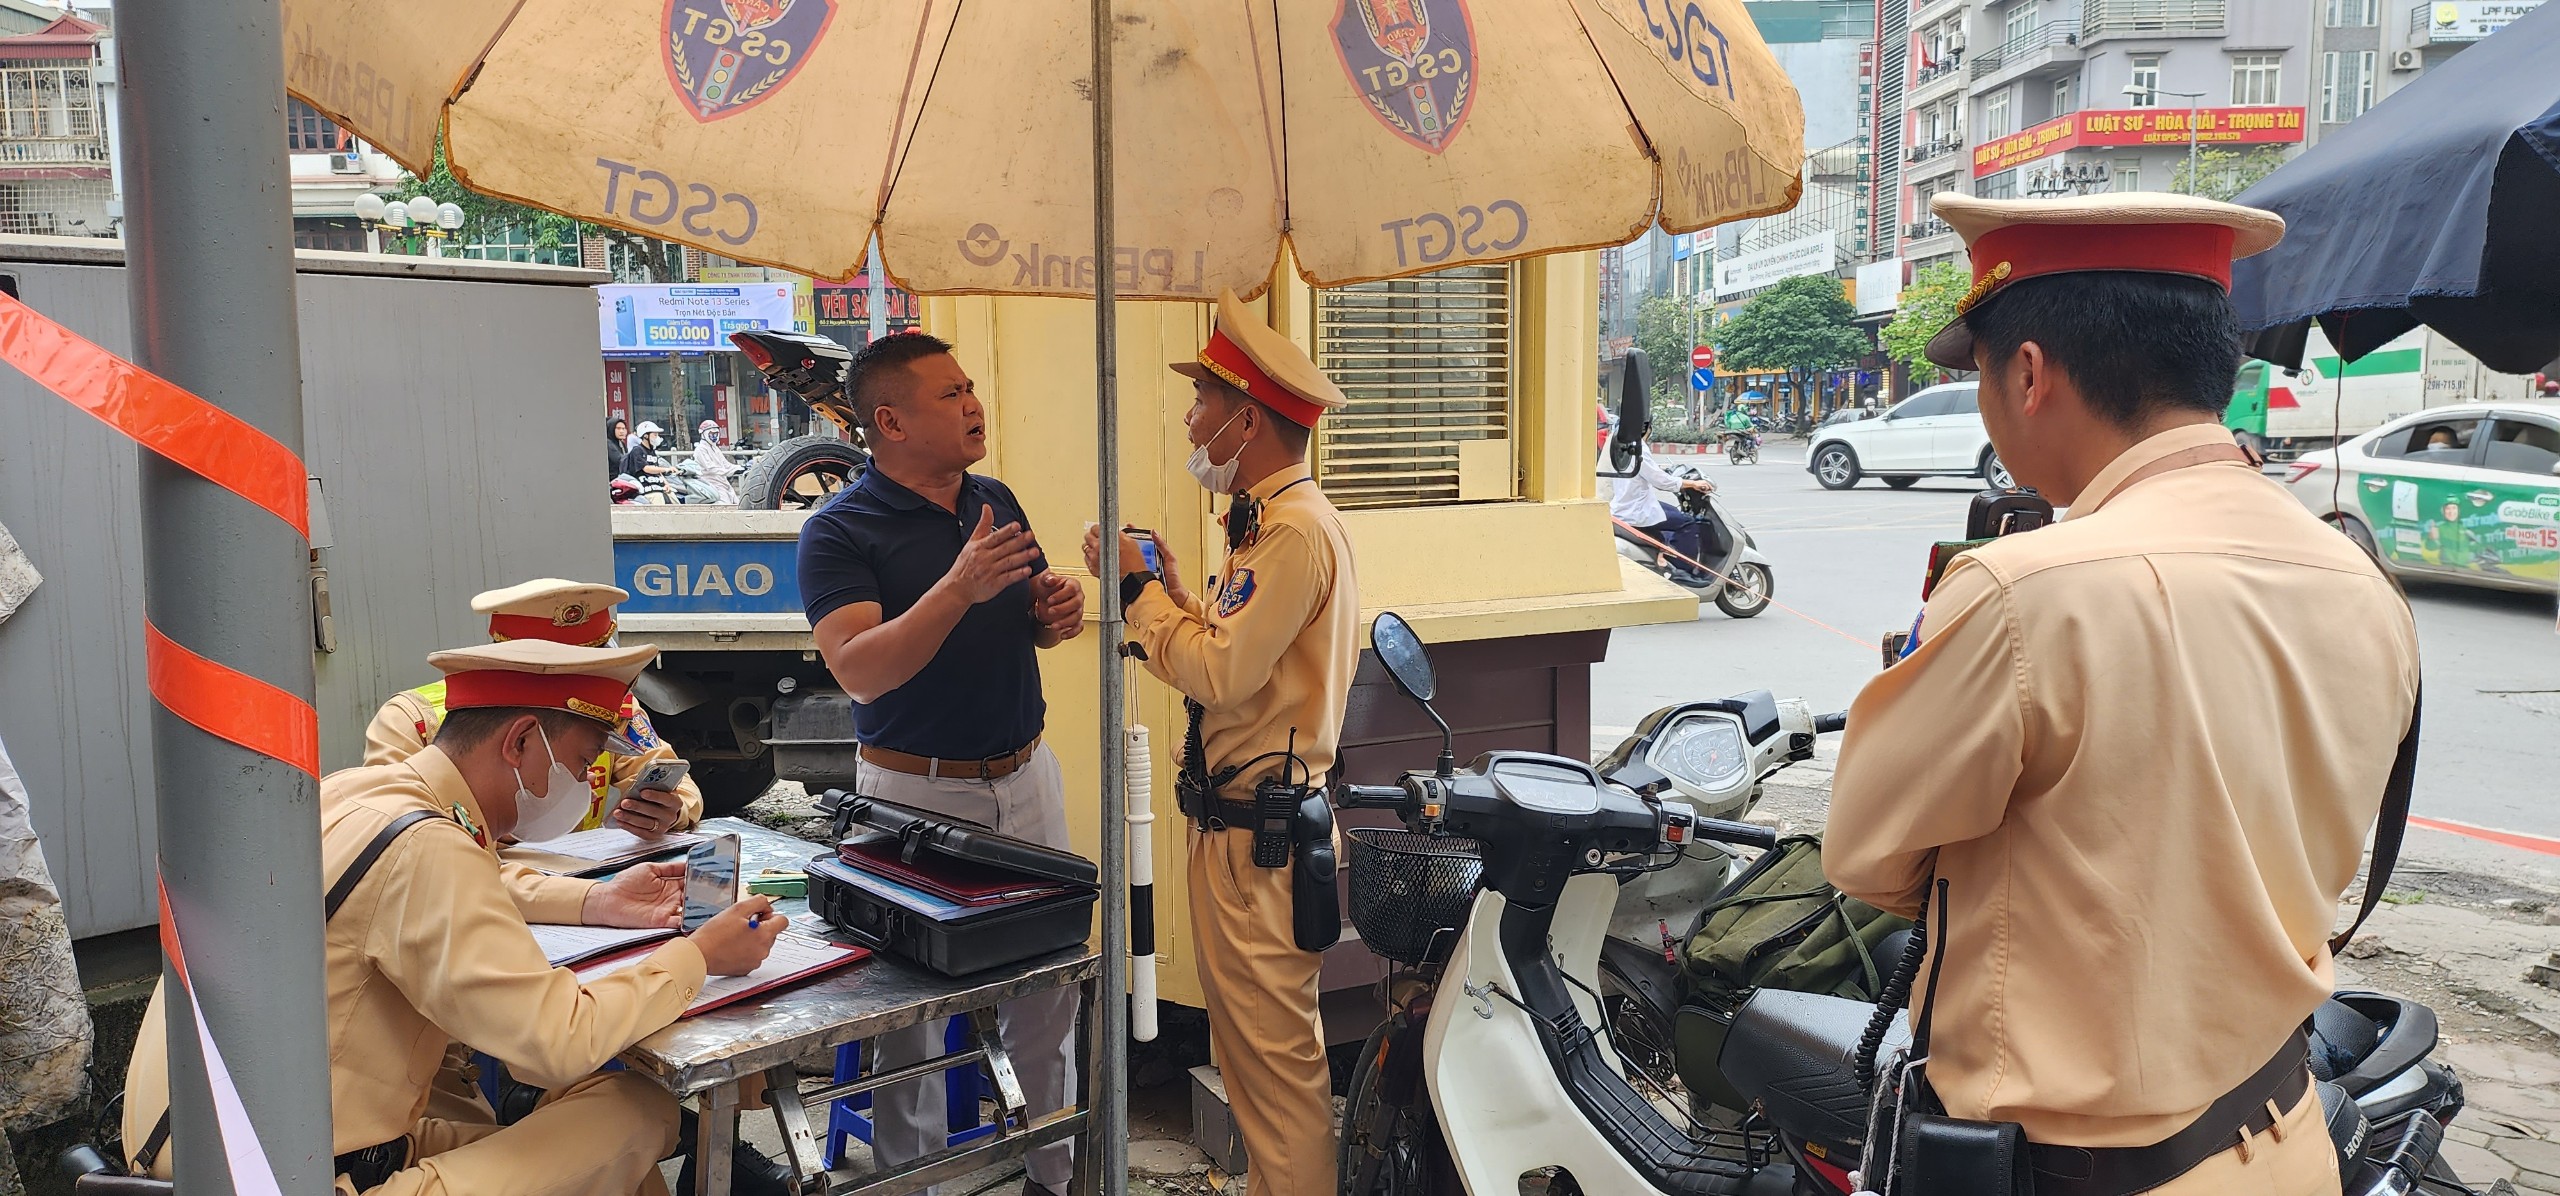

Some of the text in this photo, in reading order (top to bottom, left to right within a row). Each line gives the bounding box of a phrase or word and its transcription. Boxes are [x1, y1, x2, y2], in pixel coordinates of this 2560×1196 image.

[2482, 6, 2501, 16] LPF
[2086, 111, 2121, 136] LUẬT
[2123, 113, 2145, 132] SƯ
[2155, 111, 2184, 131] HÒA
[2228, 112, 2274, 132] TRỌNG
[2276, 109, 2299, 129] TÀI
[1975, 147, 1991, 166] LUẬT
[1990, 142, 2001, 160] SƯ
[2004, 139, 2017, 155] HÒA
[2018, 131, 2033, 151] GIẢI
[2037, 126, 2060, 146] TRỌNG
[2059, 120, 2073, 137] TÀI
[659, 297, 750, 306] Redmi Note 13 Series
[821, 289, 849, 319] YẾN
[851, 289, 870, 318] SÀ
[649, 326, 710, 340] 500.000
[610, 370, 623, 383] SÀN
[613, 386, 622, 402] GỖ
[2503, 507, 2550, 520] GrabBike
[634, 563, 774, 596] GIAO
